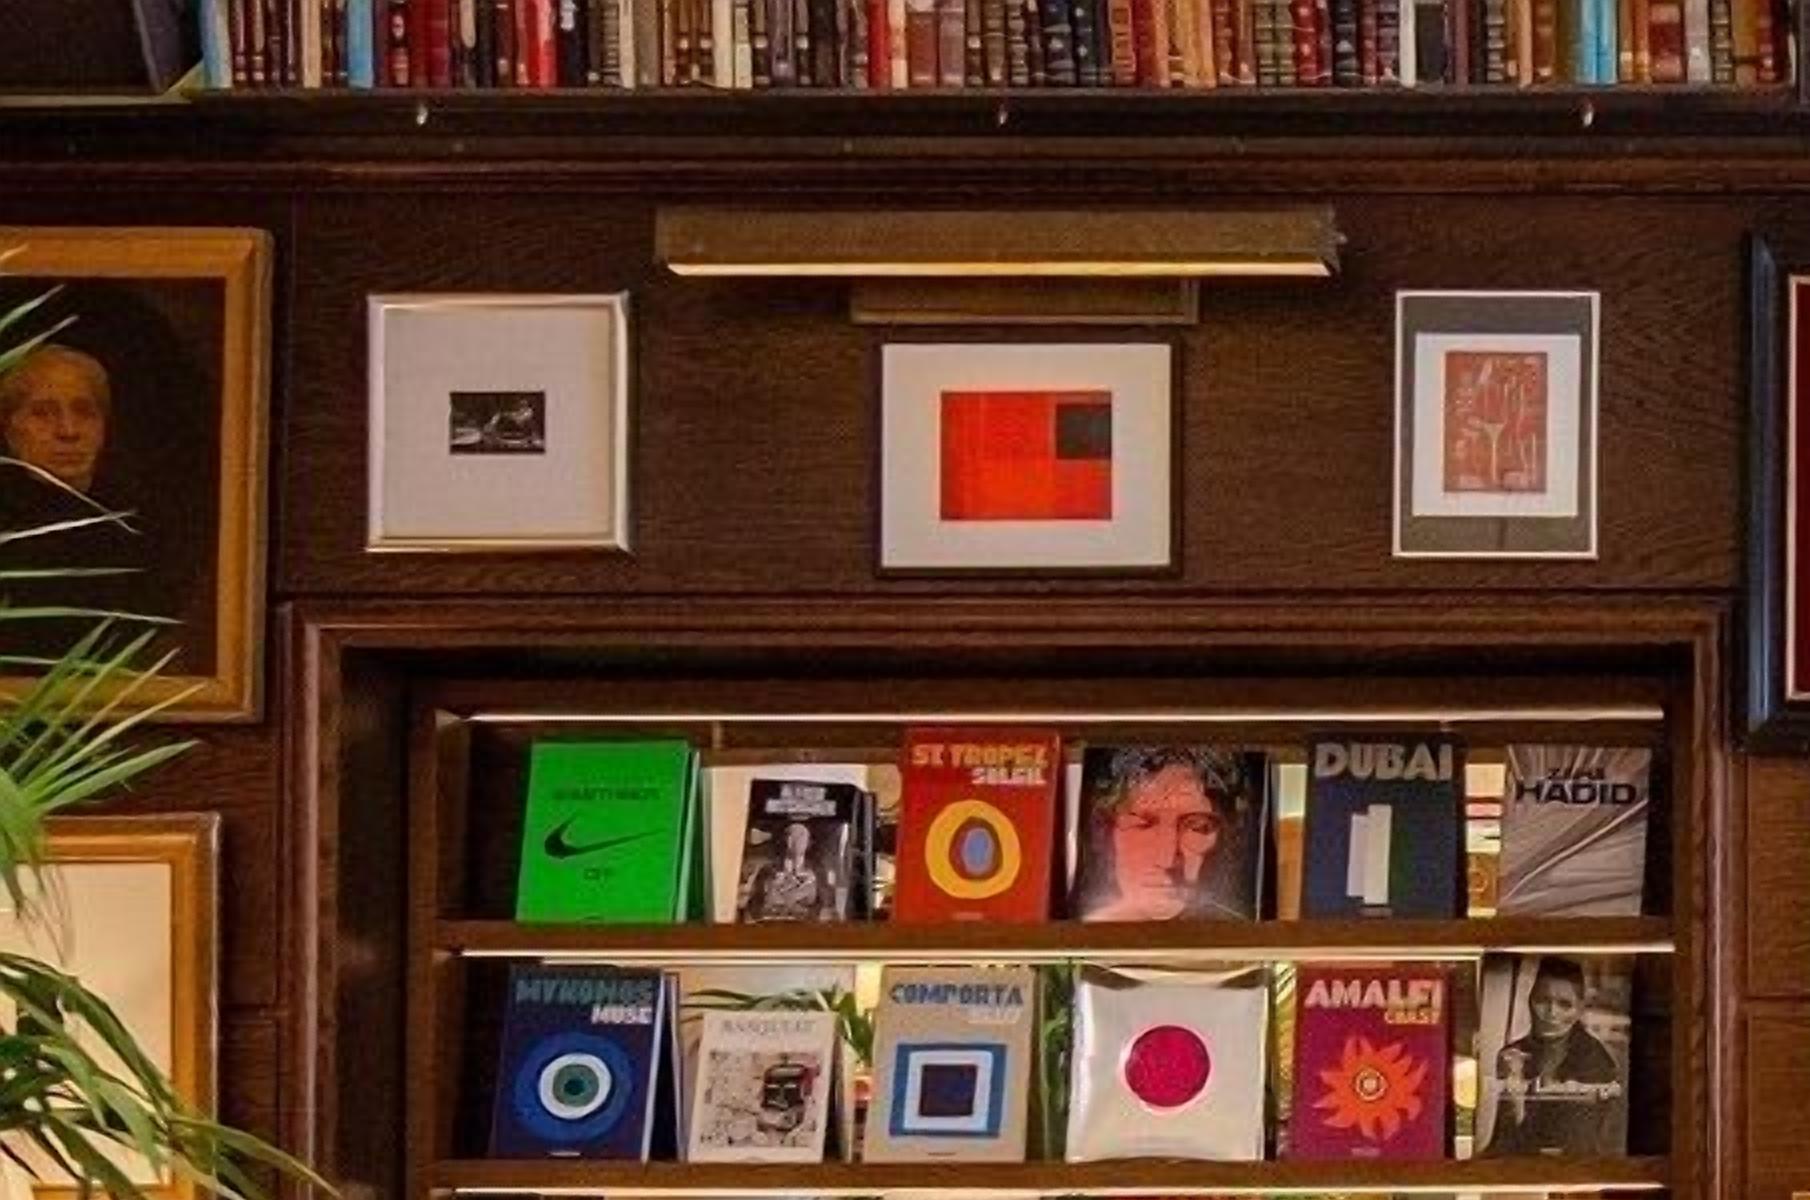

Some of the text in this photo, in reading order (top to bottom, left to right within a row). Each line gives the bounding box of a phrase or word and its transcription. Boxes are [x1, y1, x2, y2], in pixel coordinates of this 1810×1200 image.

[948, 743, 1049, 769] TROPEZ
[1314, 742, 1453, 780] DUBAI
[1516, 779, 1637, 805] HADID
[516, 979, 655, 1006] MYKONOS
[889, 981, 1025, 1006] COMPORTA
[1304, 979, 1442, 1010] AMALFI
[591, 1005, 655, 1025] MUSE
